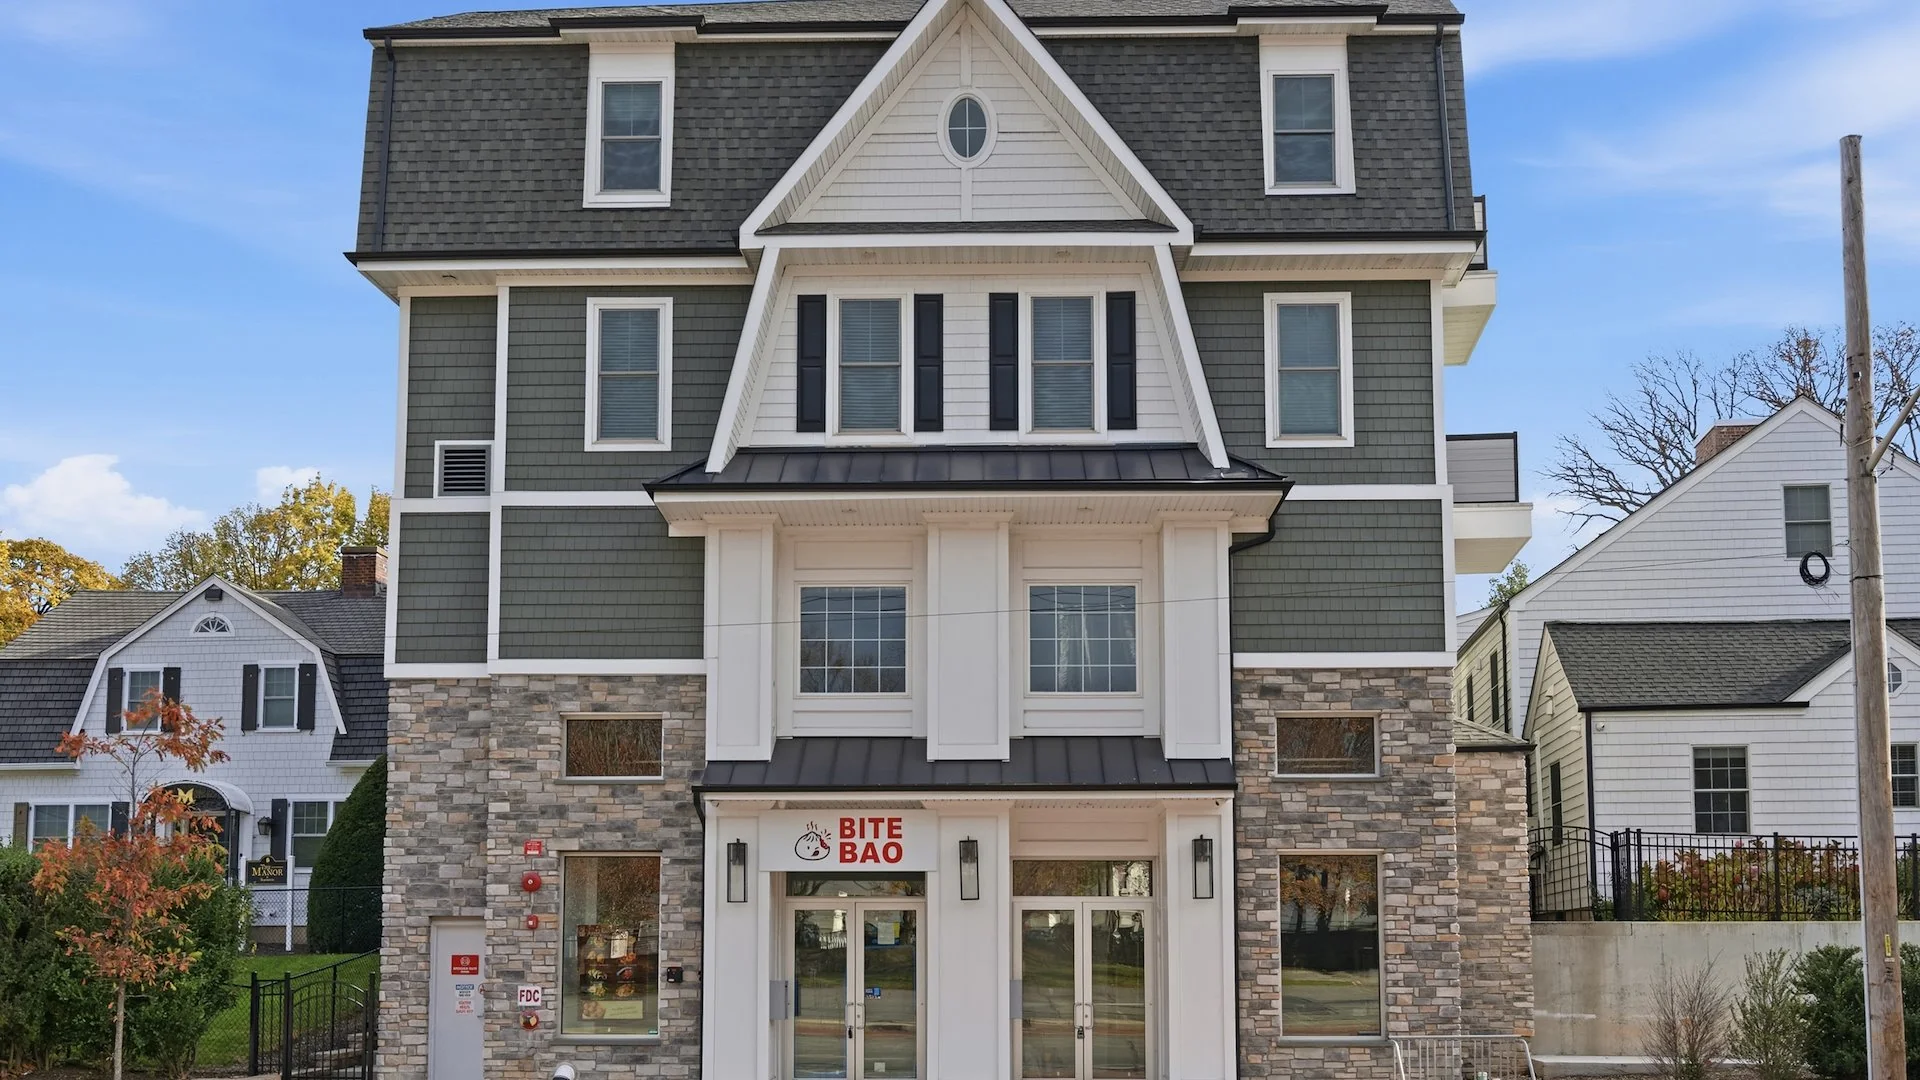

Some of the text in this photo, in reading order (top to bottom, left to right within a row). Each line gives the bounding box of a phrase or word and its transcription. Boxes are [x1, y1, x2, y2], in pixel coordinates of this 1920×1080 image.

[177, 787, 195, 805] M
[839, 817, 902, 839] BITE
[839, 841, 903, 864] BAO
[251, 867, 283, 877] MANOR
[519, 989, 540, 1003] FDC
